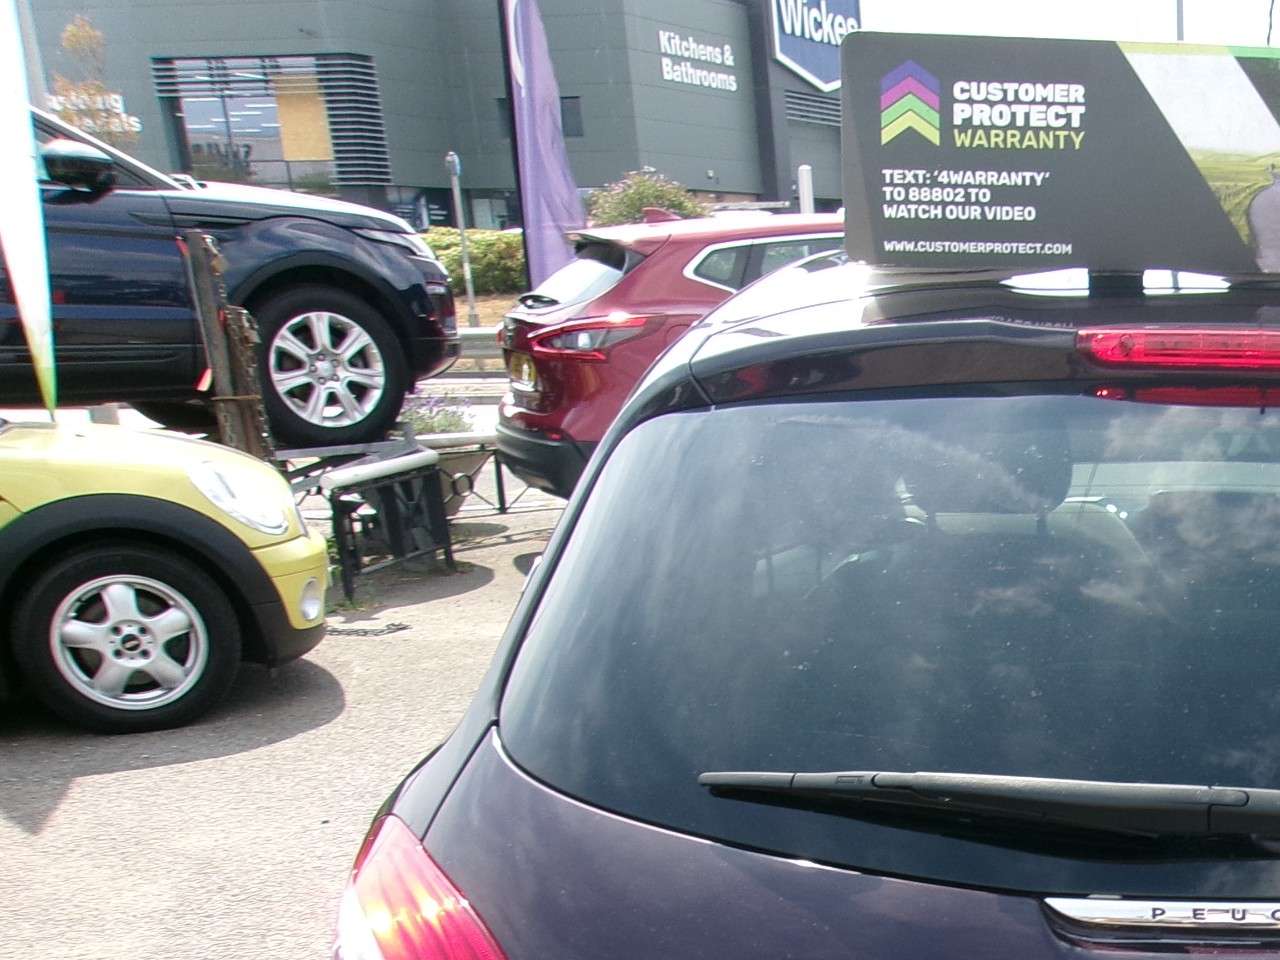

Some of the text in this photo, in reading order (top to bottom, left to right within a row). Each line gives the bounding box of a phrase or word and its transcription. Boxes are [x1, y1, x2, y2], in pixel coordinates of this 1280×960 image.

[659, 30, 735, 67] Kitchens &
[661, 57, 737, 92] Bathrooms
[953, 80, 1086, 103] CUSTOMER
[953, 102, 1086, 128] PROTECT
[953, 128, 1086, 150] WARRANTY
[881, 169, 931, 184] TEXT:
[881, 186, 991, 202] TO 88802 TO
[882, 204, 1036, 221] WATCH OUR VIDEO
[883, 241, 1073, 255] WWW.CUSTOMERPROTECT.COM
